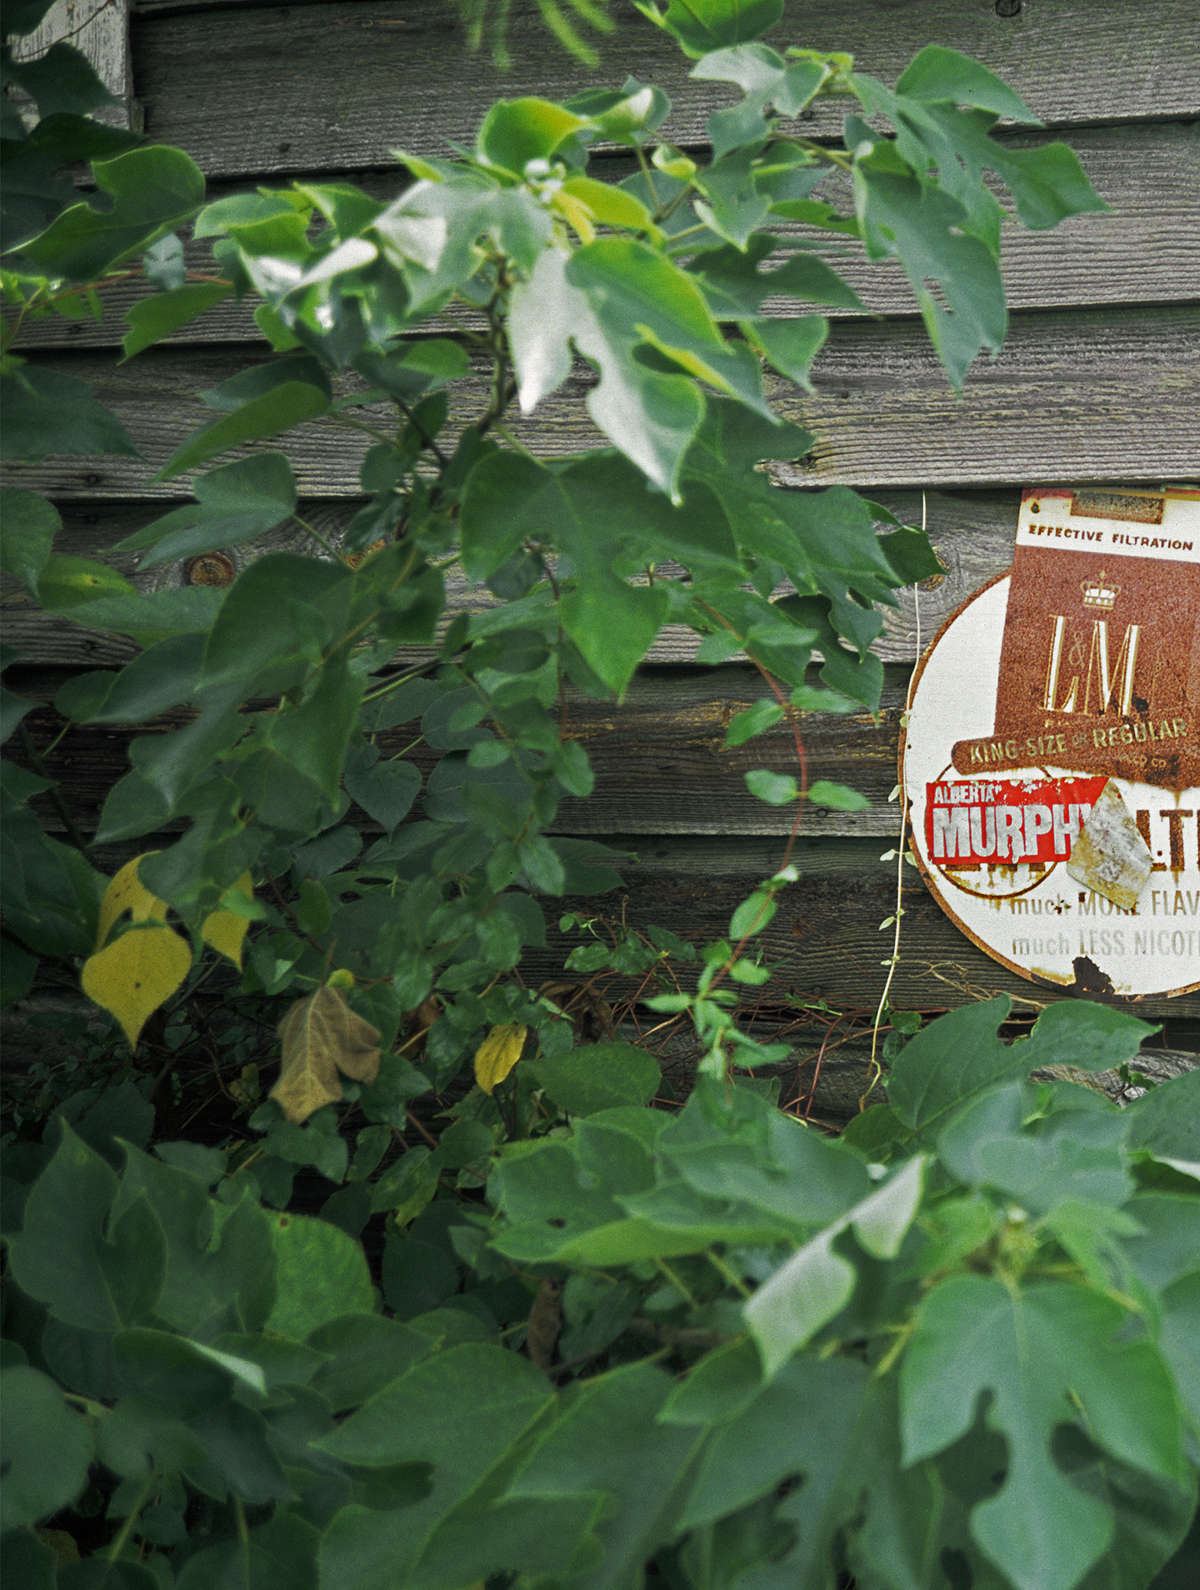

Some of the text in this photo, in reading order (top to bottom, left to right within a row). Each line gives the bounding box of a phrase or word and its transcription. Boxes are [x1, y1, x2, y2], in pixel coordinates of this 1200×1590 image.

[1028, 523, 1194, 551] EFFECTIVE FILTRATION
[969, 733, 1069, 764] KING-SIZE
[1092, 717, 1188, 749] REGULAR
[1011, 932, 1070, 955] much
[1078, 929, 1125, 956] LESS
